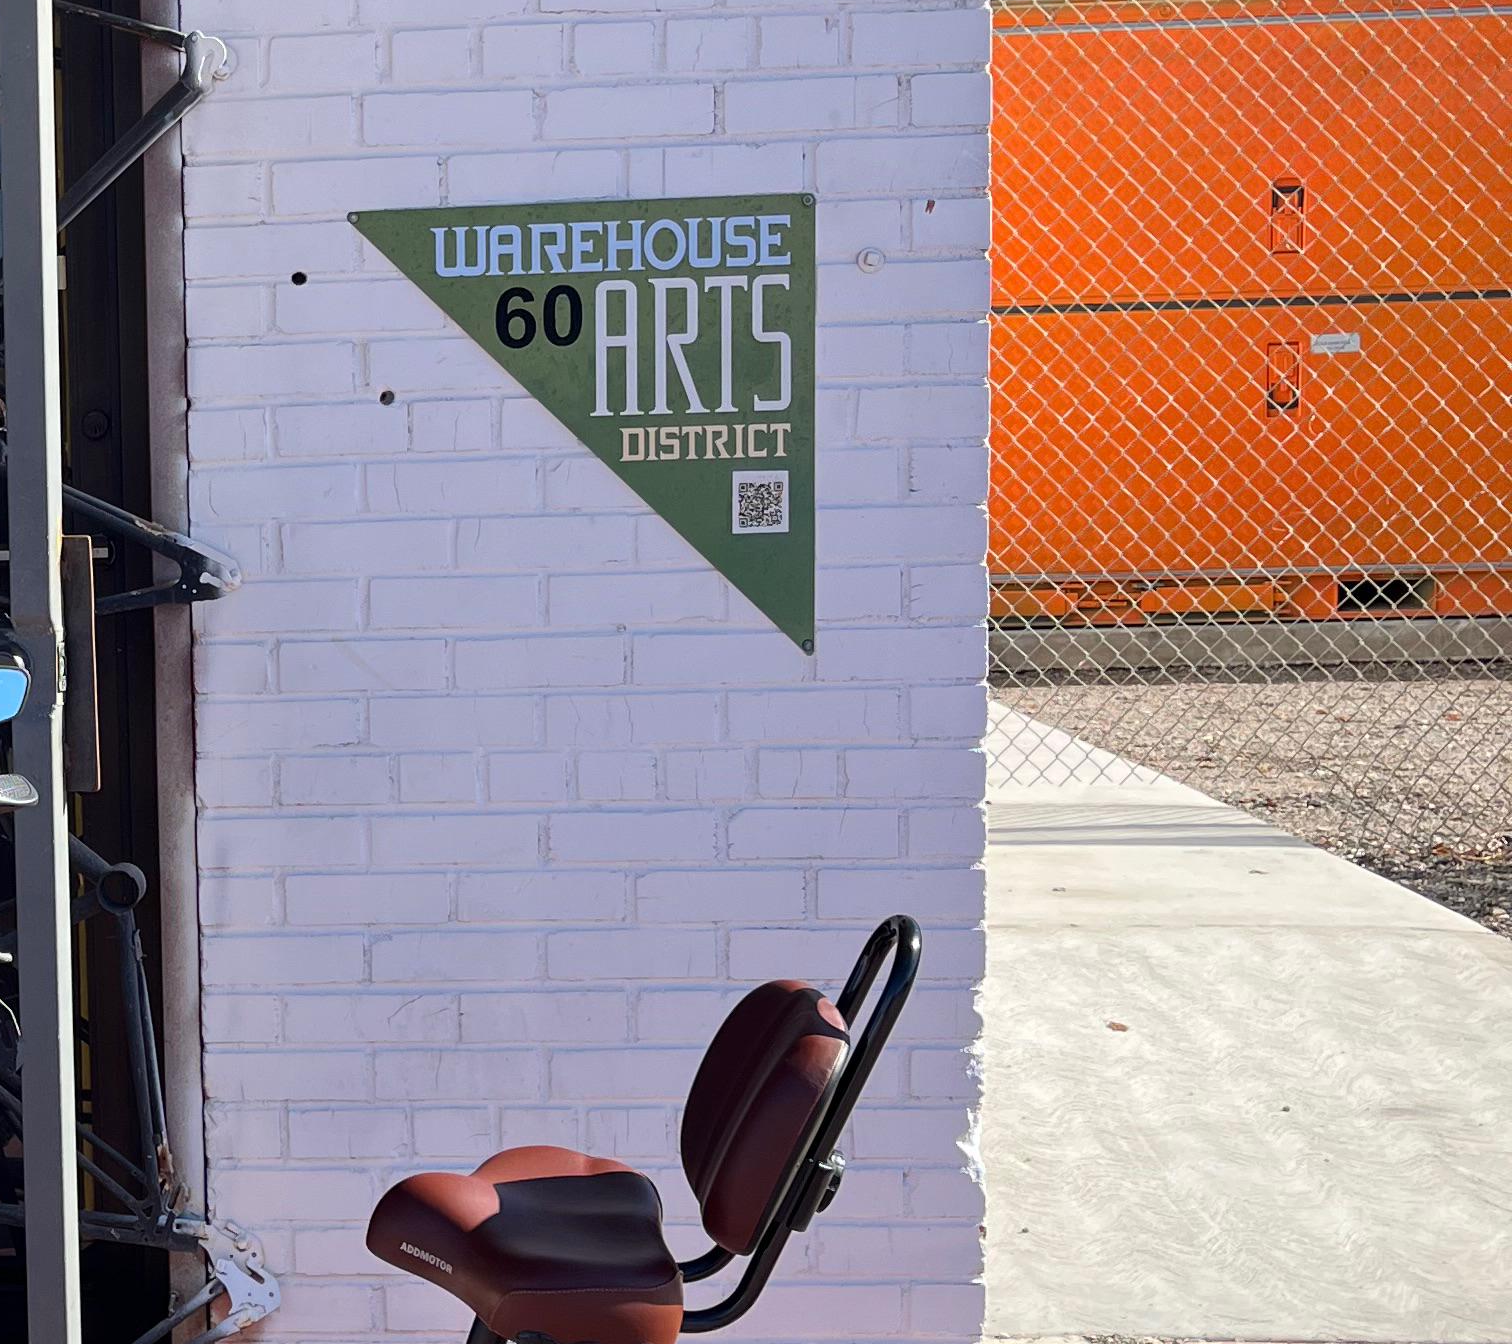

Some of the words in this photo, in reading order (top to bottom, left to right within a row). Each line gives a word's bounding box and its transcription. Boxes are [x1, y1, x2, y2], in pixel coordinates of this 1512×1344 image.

[430, 215, 792, 278] WAREHOUSE
[495, 285, 584, 349] 60
[590, 274, 792, 417] ARTS
[619, 423, 792, 463] DISTRICT
[399, 1241, 453, 1275] ADDMOTOR
